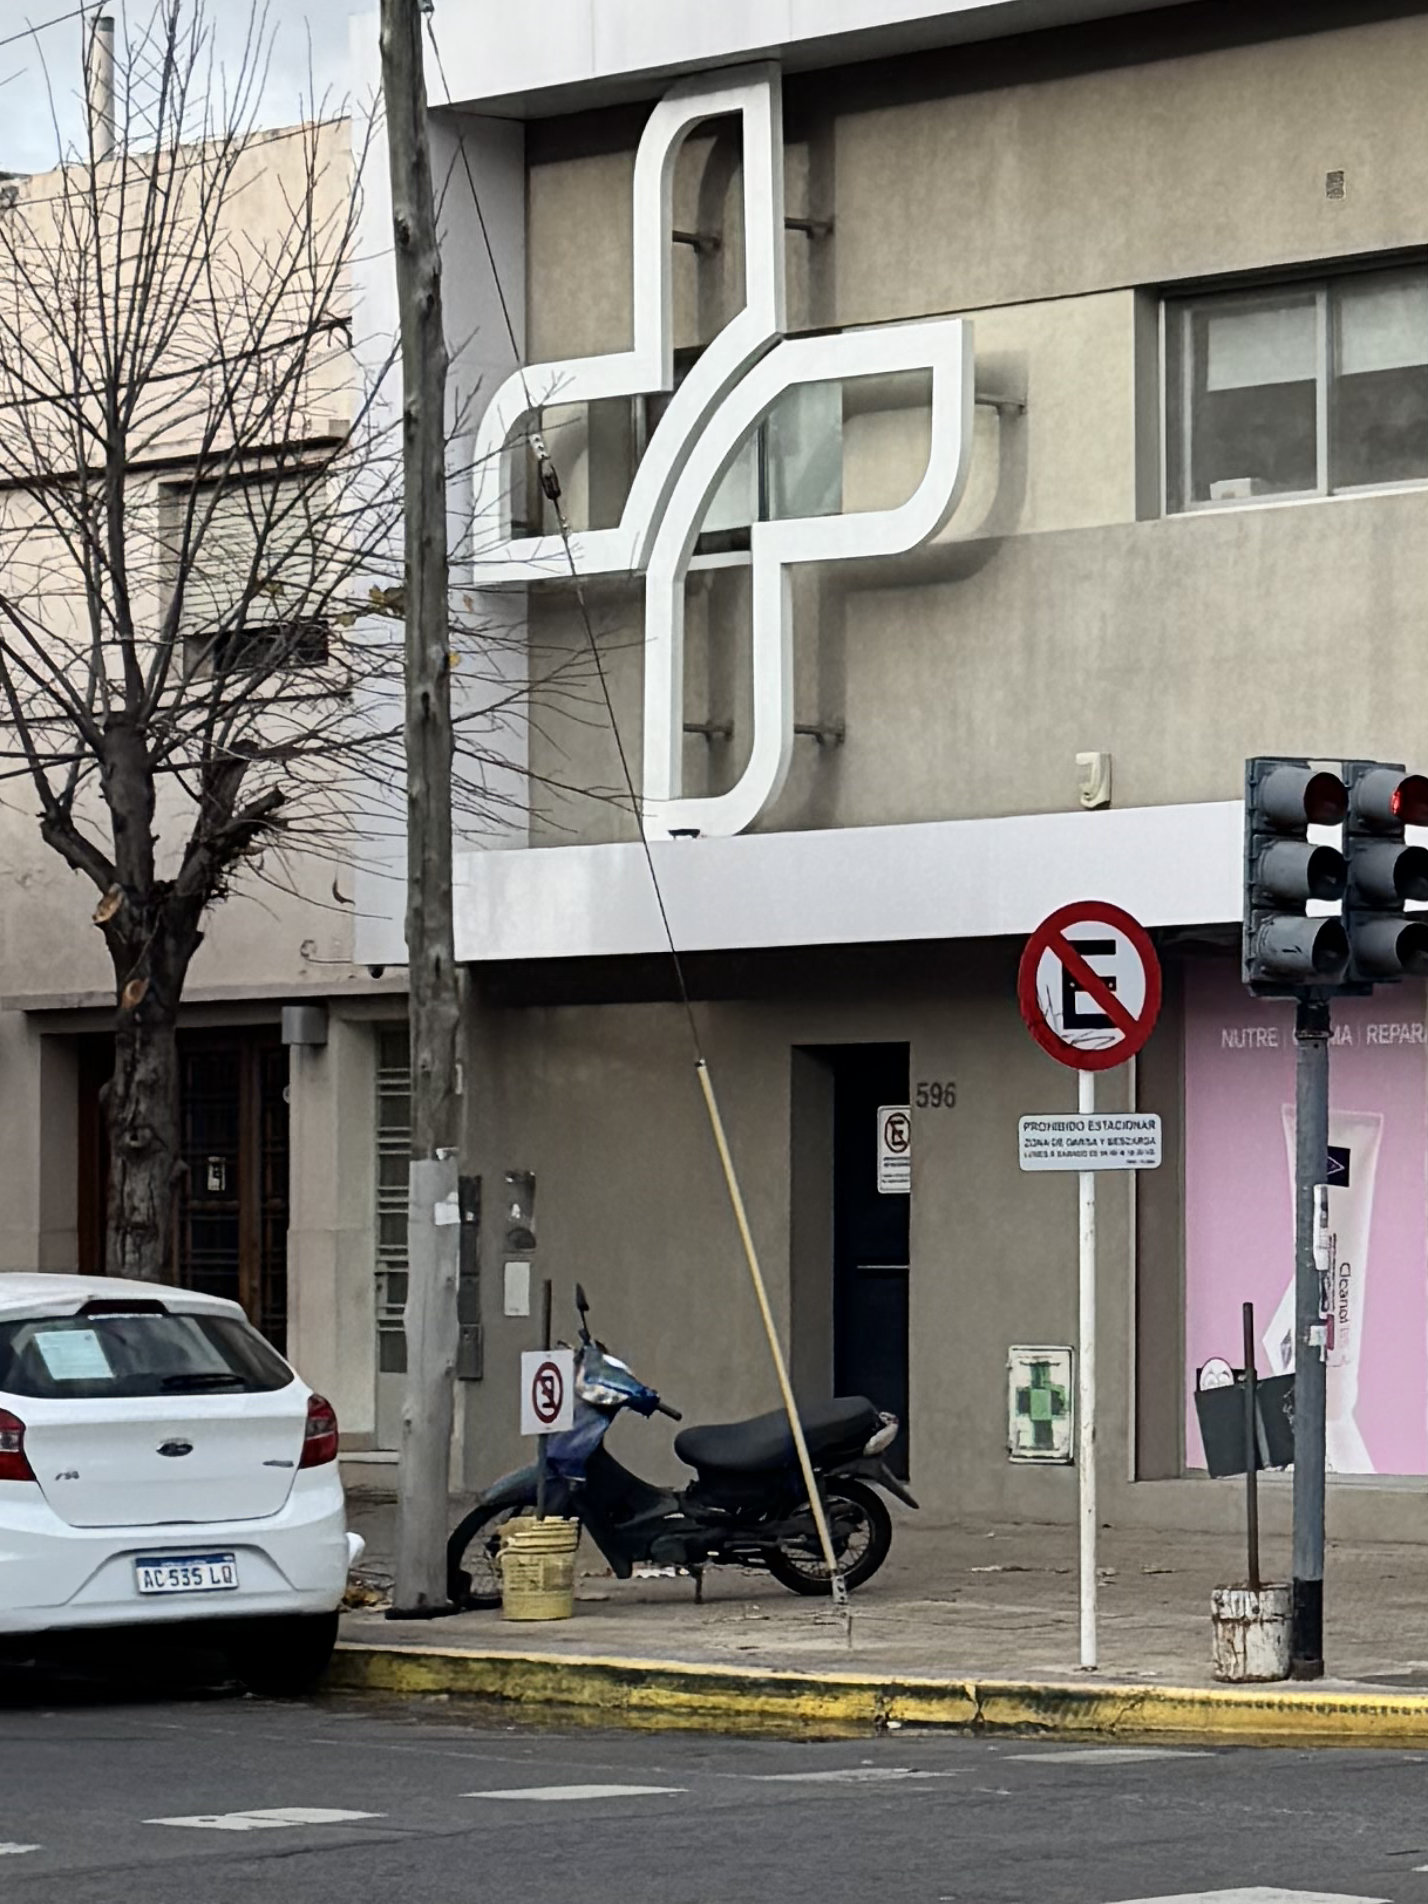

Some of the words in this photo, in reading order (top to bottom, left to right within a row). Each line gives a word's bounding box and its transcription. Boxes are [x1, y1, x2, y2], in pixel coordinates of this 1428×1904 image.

[1221, 1027, 1279, 1049] NUTRE
[915, 1081, 957, 1108] 596
[1023, 1121, 1085, 1132] PROHIBIDO
[1088, 1119, 1156, 1131] ESTACIONAR
[144, 1570, 165, 1588] AC
[169, 1567, 203, 1586] 535
